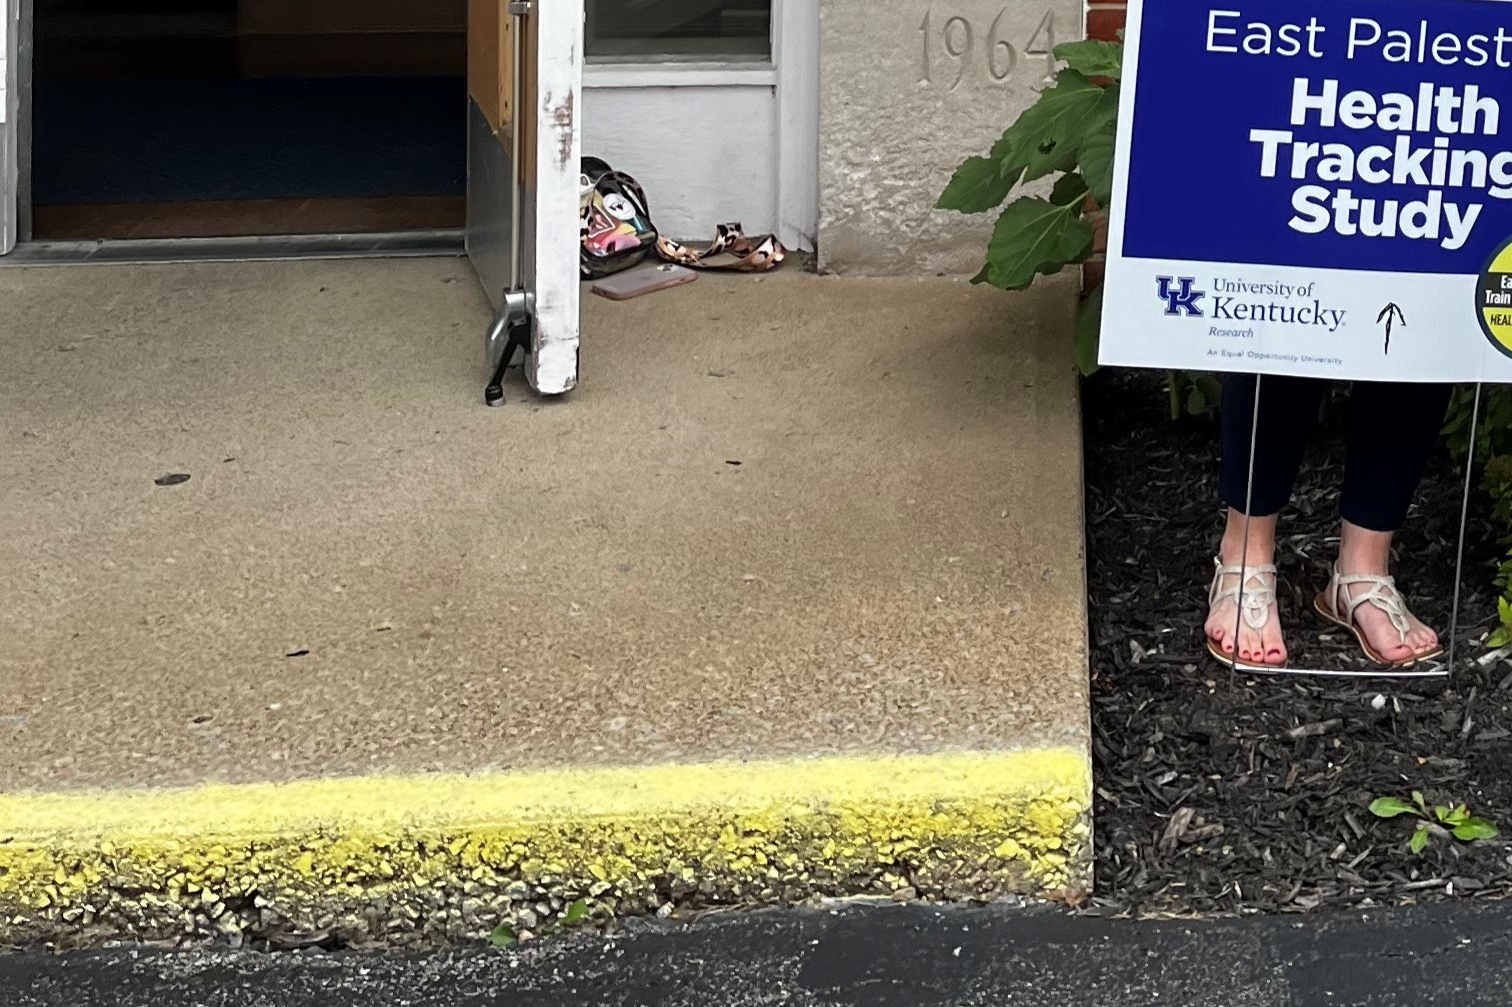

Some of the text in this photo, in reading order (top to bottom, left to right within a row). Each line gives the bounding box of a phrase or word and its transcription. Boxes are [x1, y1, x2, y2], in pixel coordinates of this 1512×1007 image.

[916, 7, 1055, 92] 1964
[1206, 9, 1326, 58] East
[1290, 77, 1499, 136] Health
[1288, 186, 1483, 250] Study
[1155, 274, 1205, 317] UK
[1213, 277, 1315, 299] University of
[1485, 290, 1510, 304] Train
[1209, 326, 1254, 338] Research
[1221, 349, 1244, 358] Equal
[1247, 350, 1298, 363] Opportunity
[1301, 355, 1343, 365] University
